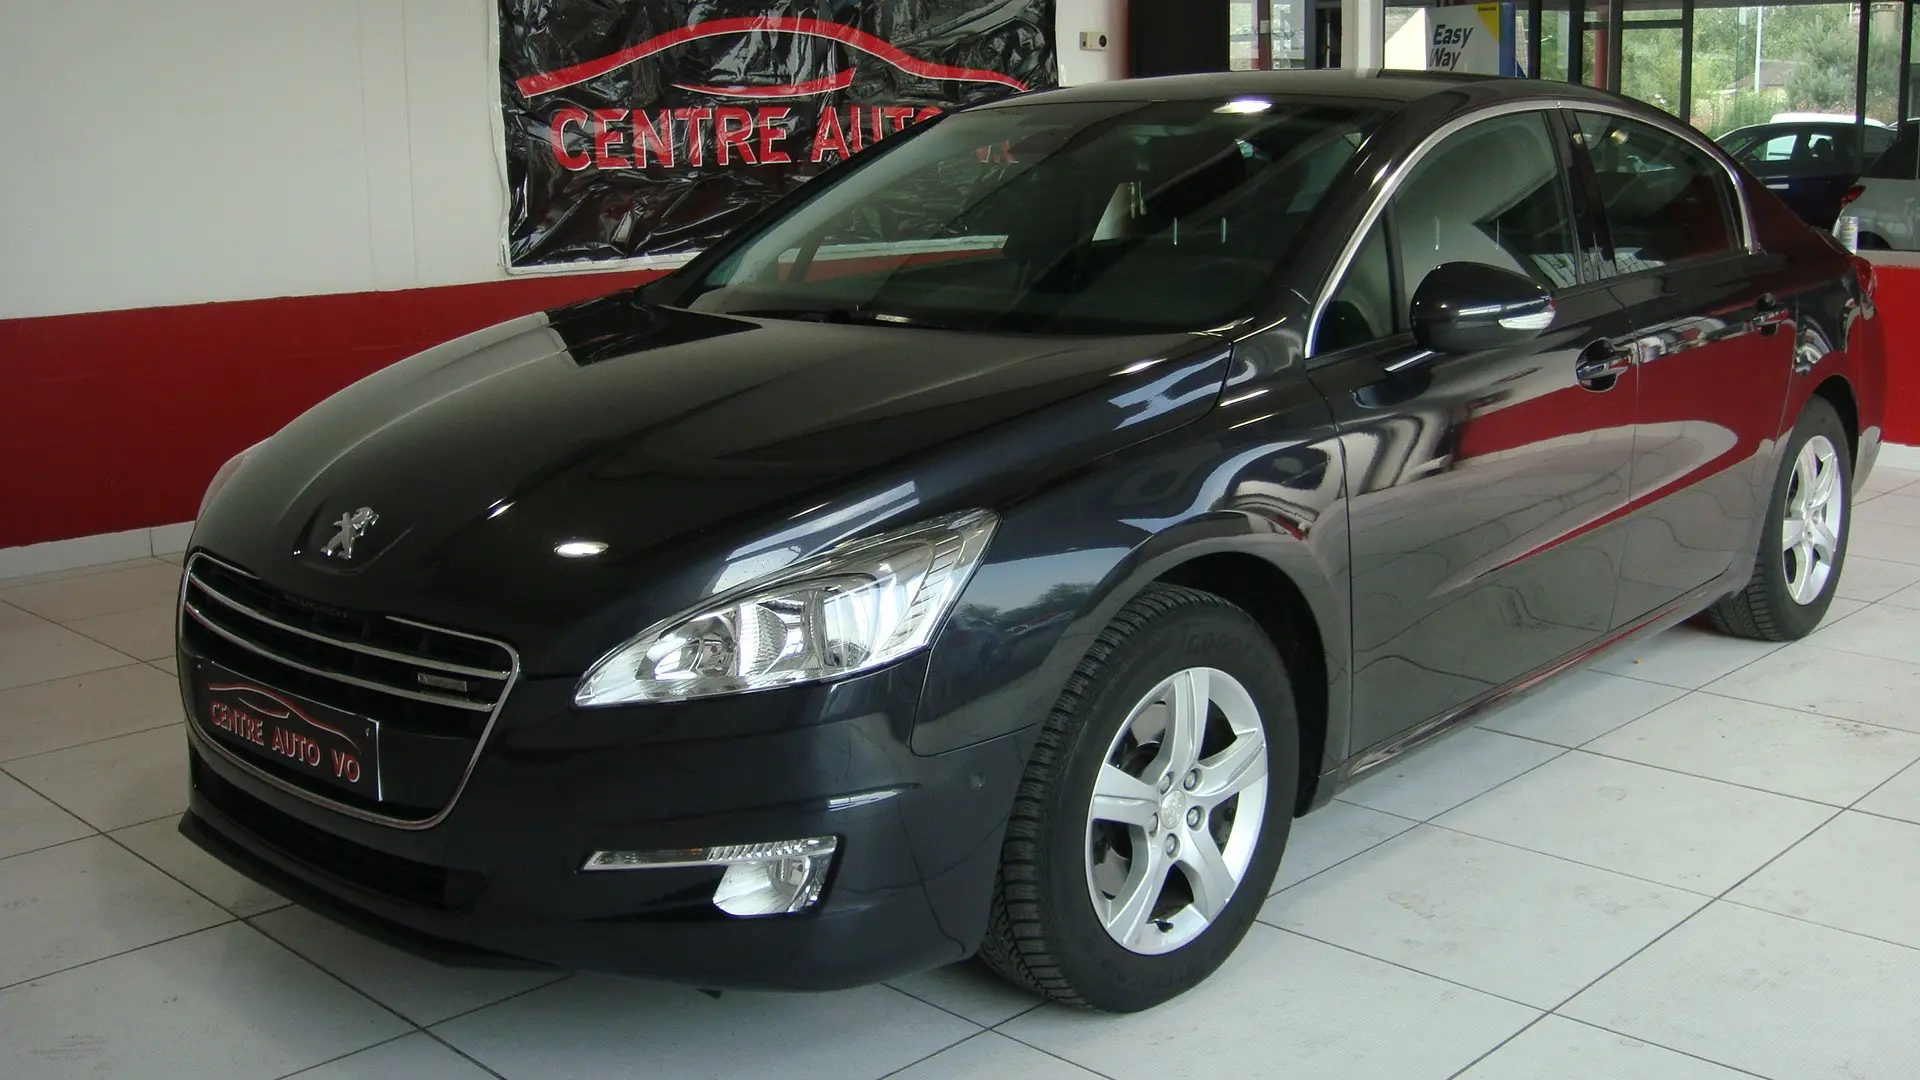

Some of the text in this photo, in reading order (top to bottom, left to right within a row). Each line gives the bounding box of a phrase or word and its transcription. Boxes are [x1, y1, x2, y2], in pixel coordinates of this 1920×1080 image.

[1433, 24, 1474, 48] Easy
[1429, 48, 1461, 71] Way
[552, 105, 943, 171] CENTRE AUT
[211, 701, 360, 783] CENTRE AUTO VO
